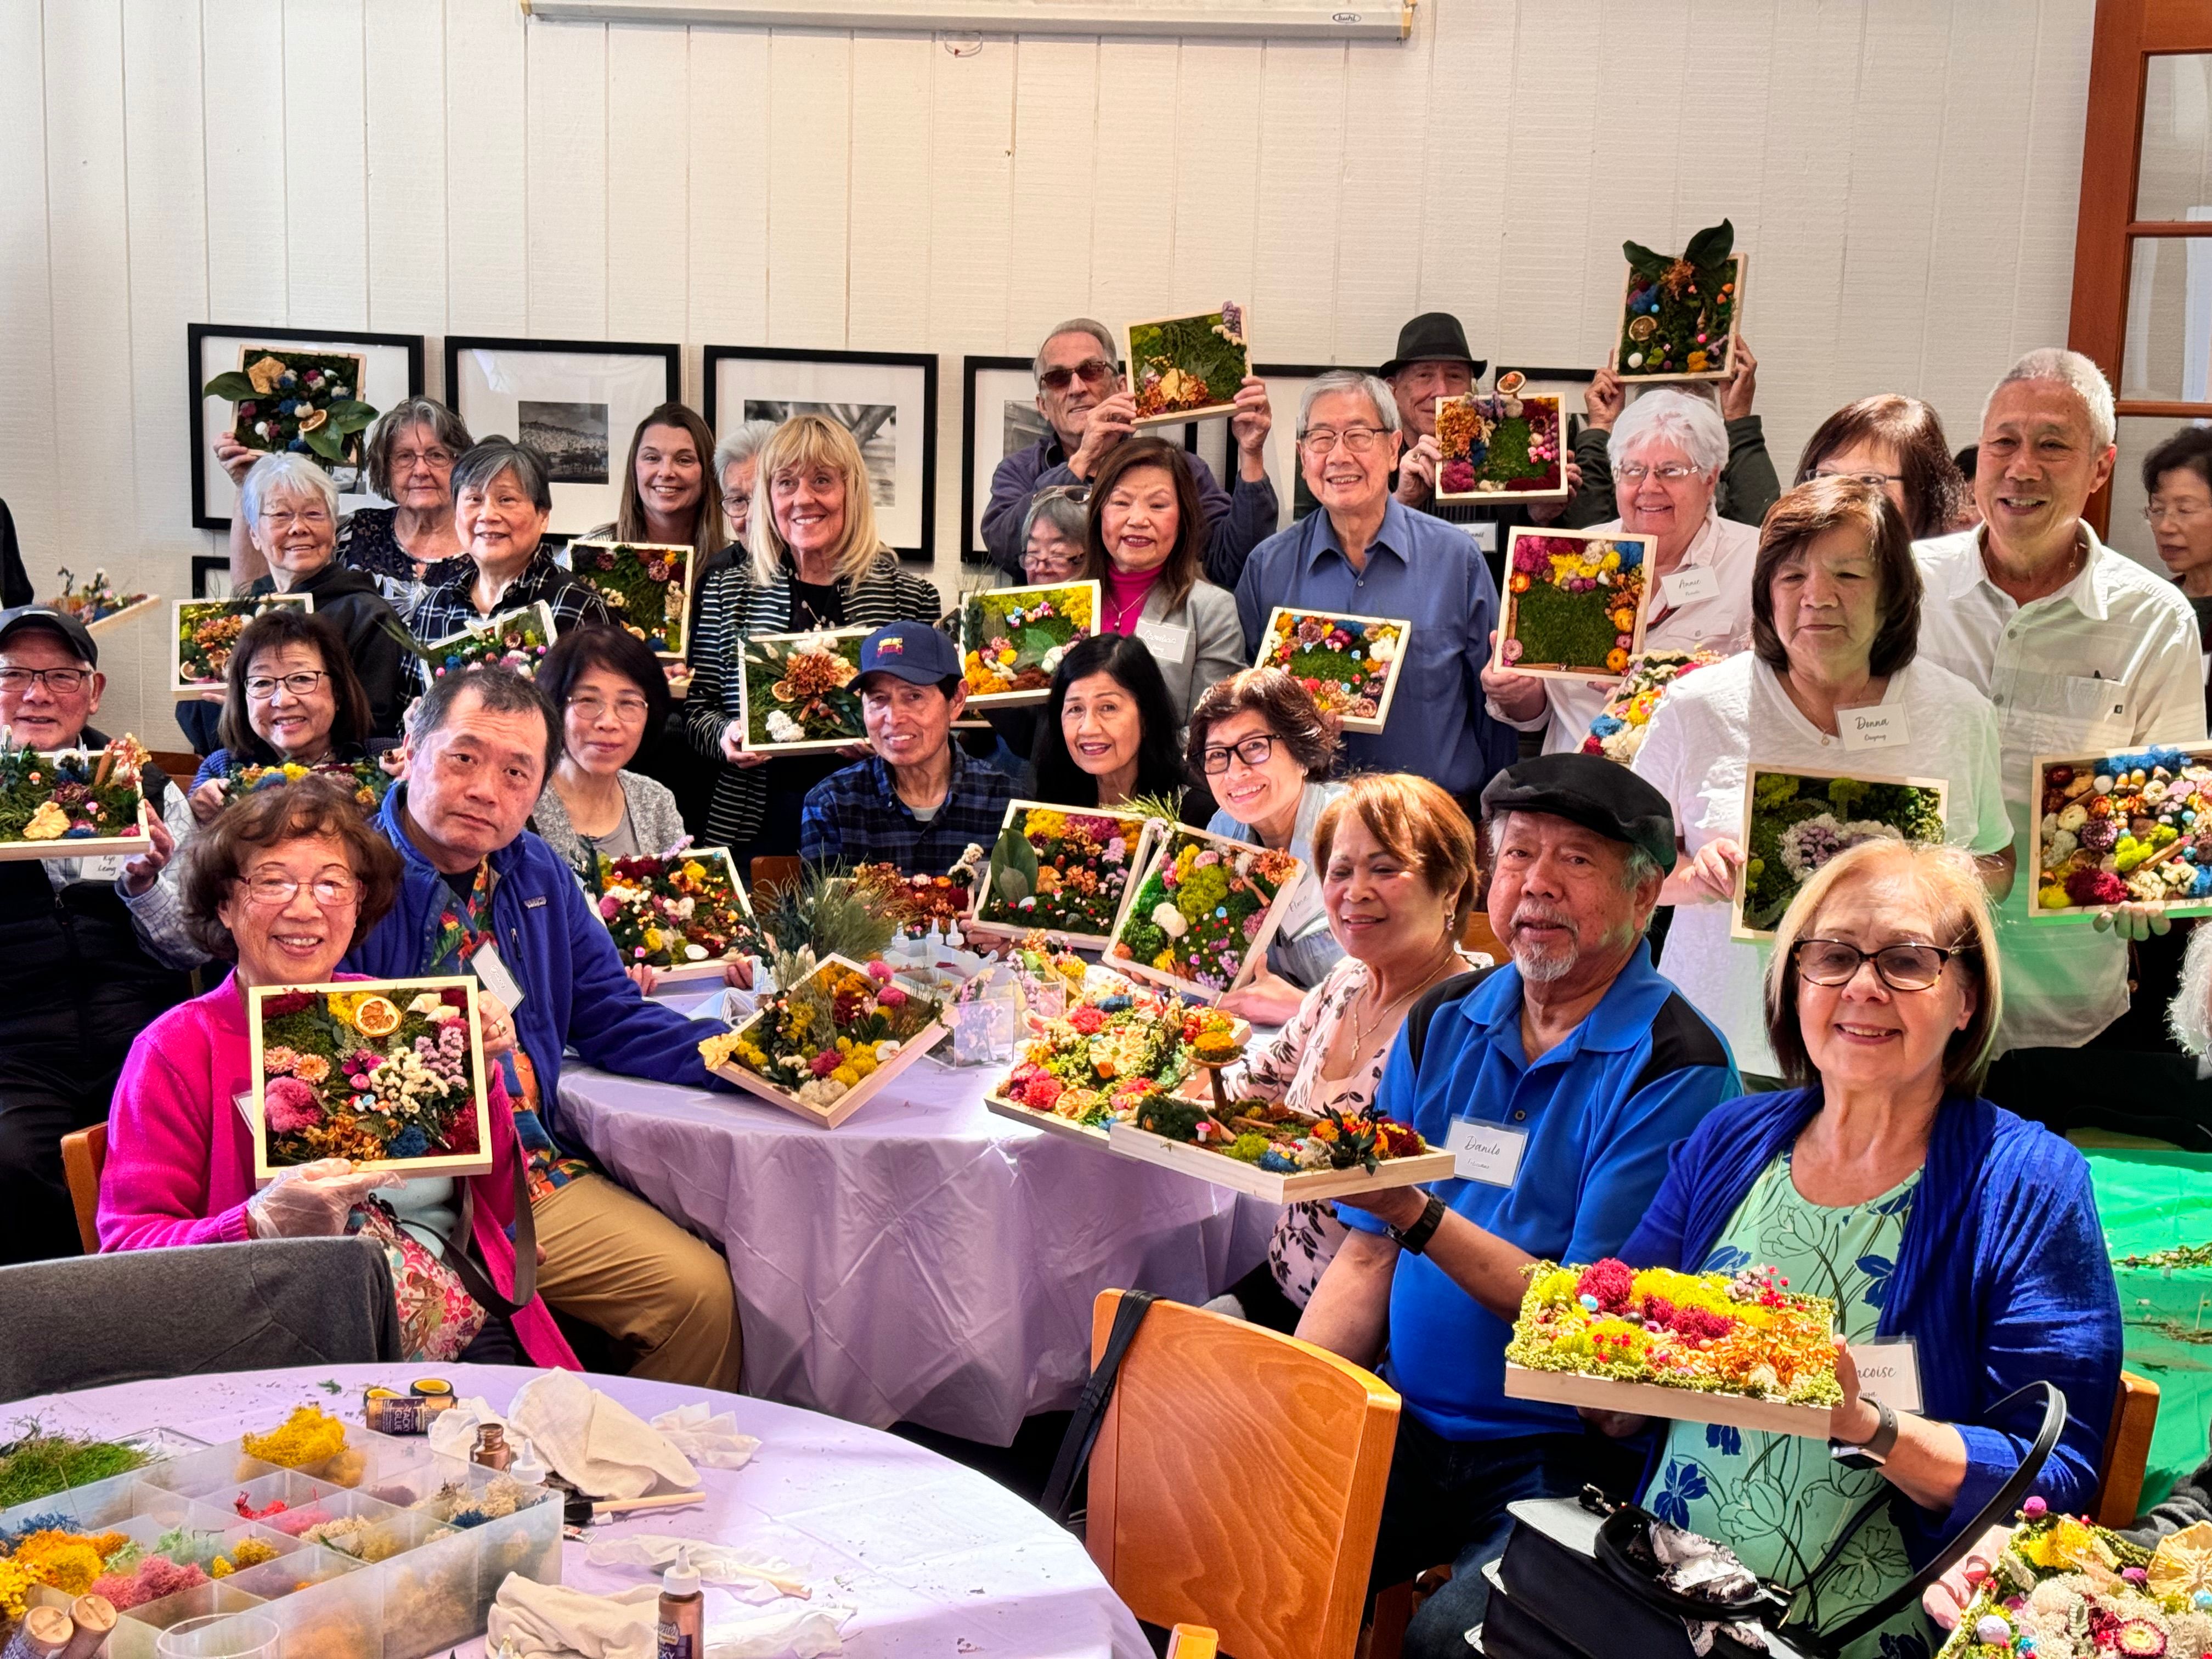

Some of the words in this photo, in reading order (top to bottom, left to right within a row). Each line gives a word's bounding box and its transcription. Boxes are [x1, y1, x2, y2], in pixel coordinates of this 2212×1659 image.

[1855, 716, 1890, 730] Donna
[1464, 1135, 1501, 1155] Danilo
[1857, 1366, 1897, 1378] ncoise
[394, 1409, 403, 1431] GLUE
